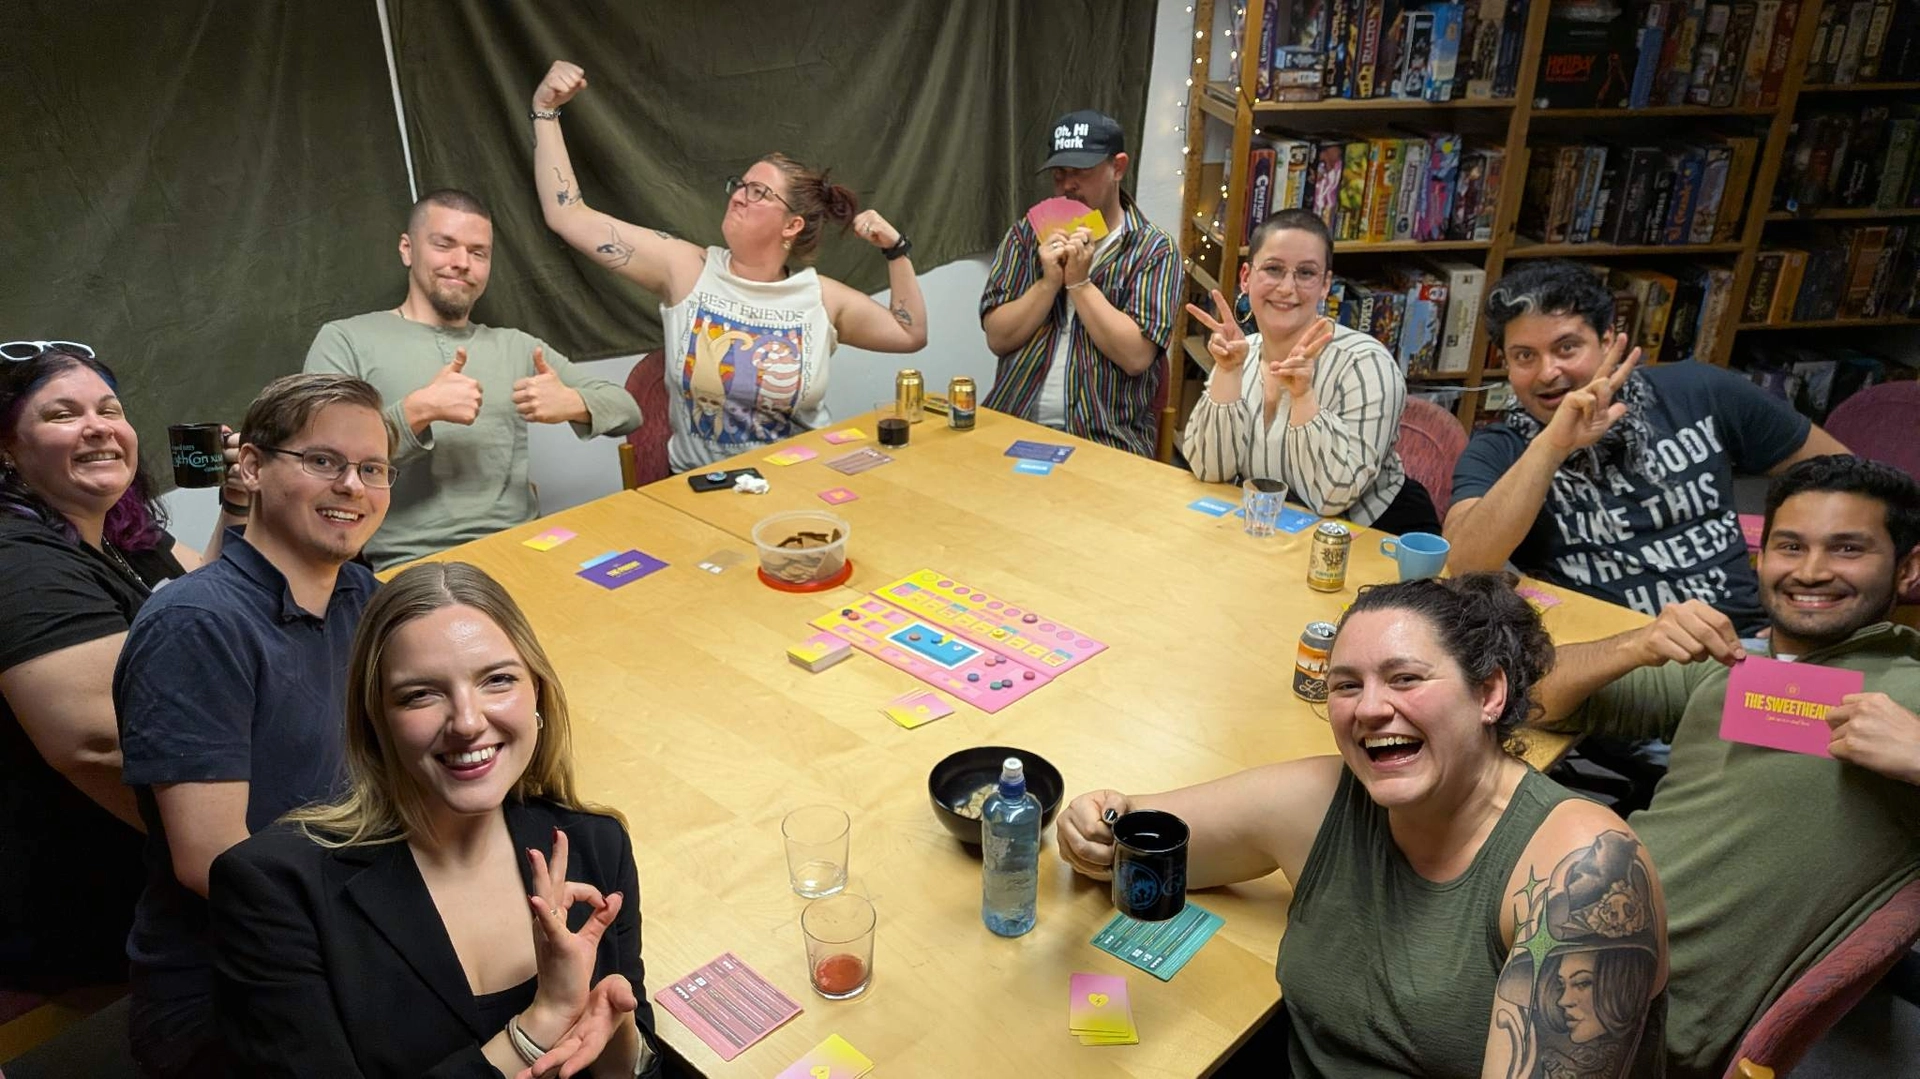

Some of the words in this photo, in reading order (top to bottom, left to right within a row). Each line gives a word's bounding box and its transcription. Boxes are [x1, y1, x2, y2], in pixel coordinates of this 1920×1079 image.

[1362, 19, 1376, 64] RIALTO
[1547, 54, 1597, 78] HELLBOY
[1055, 124, 1072, 139] Oh,
[1055, 136, 1084, 150] Mark
[700, 291, 737, 315] BEST
[740, 305, 804, 322] FRIENDS
[1555, 506, 1635, 546] LIKE
[1639, 472, 1720, 530] THIS
[1640, 509, 1740, 573] NEEDS
[1744, 691, 1767, 711] THE
